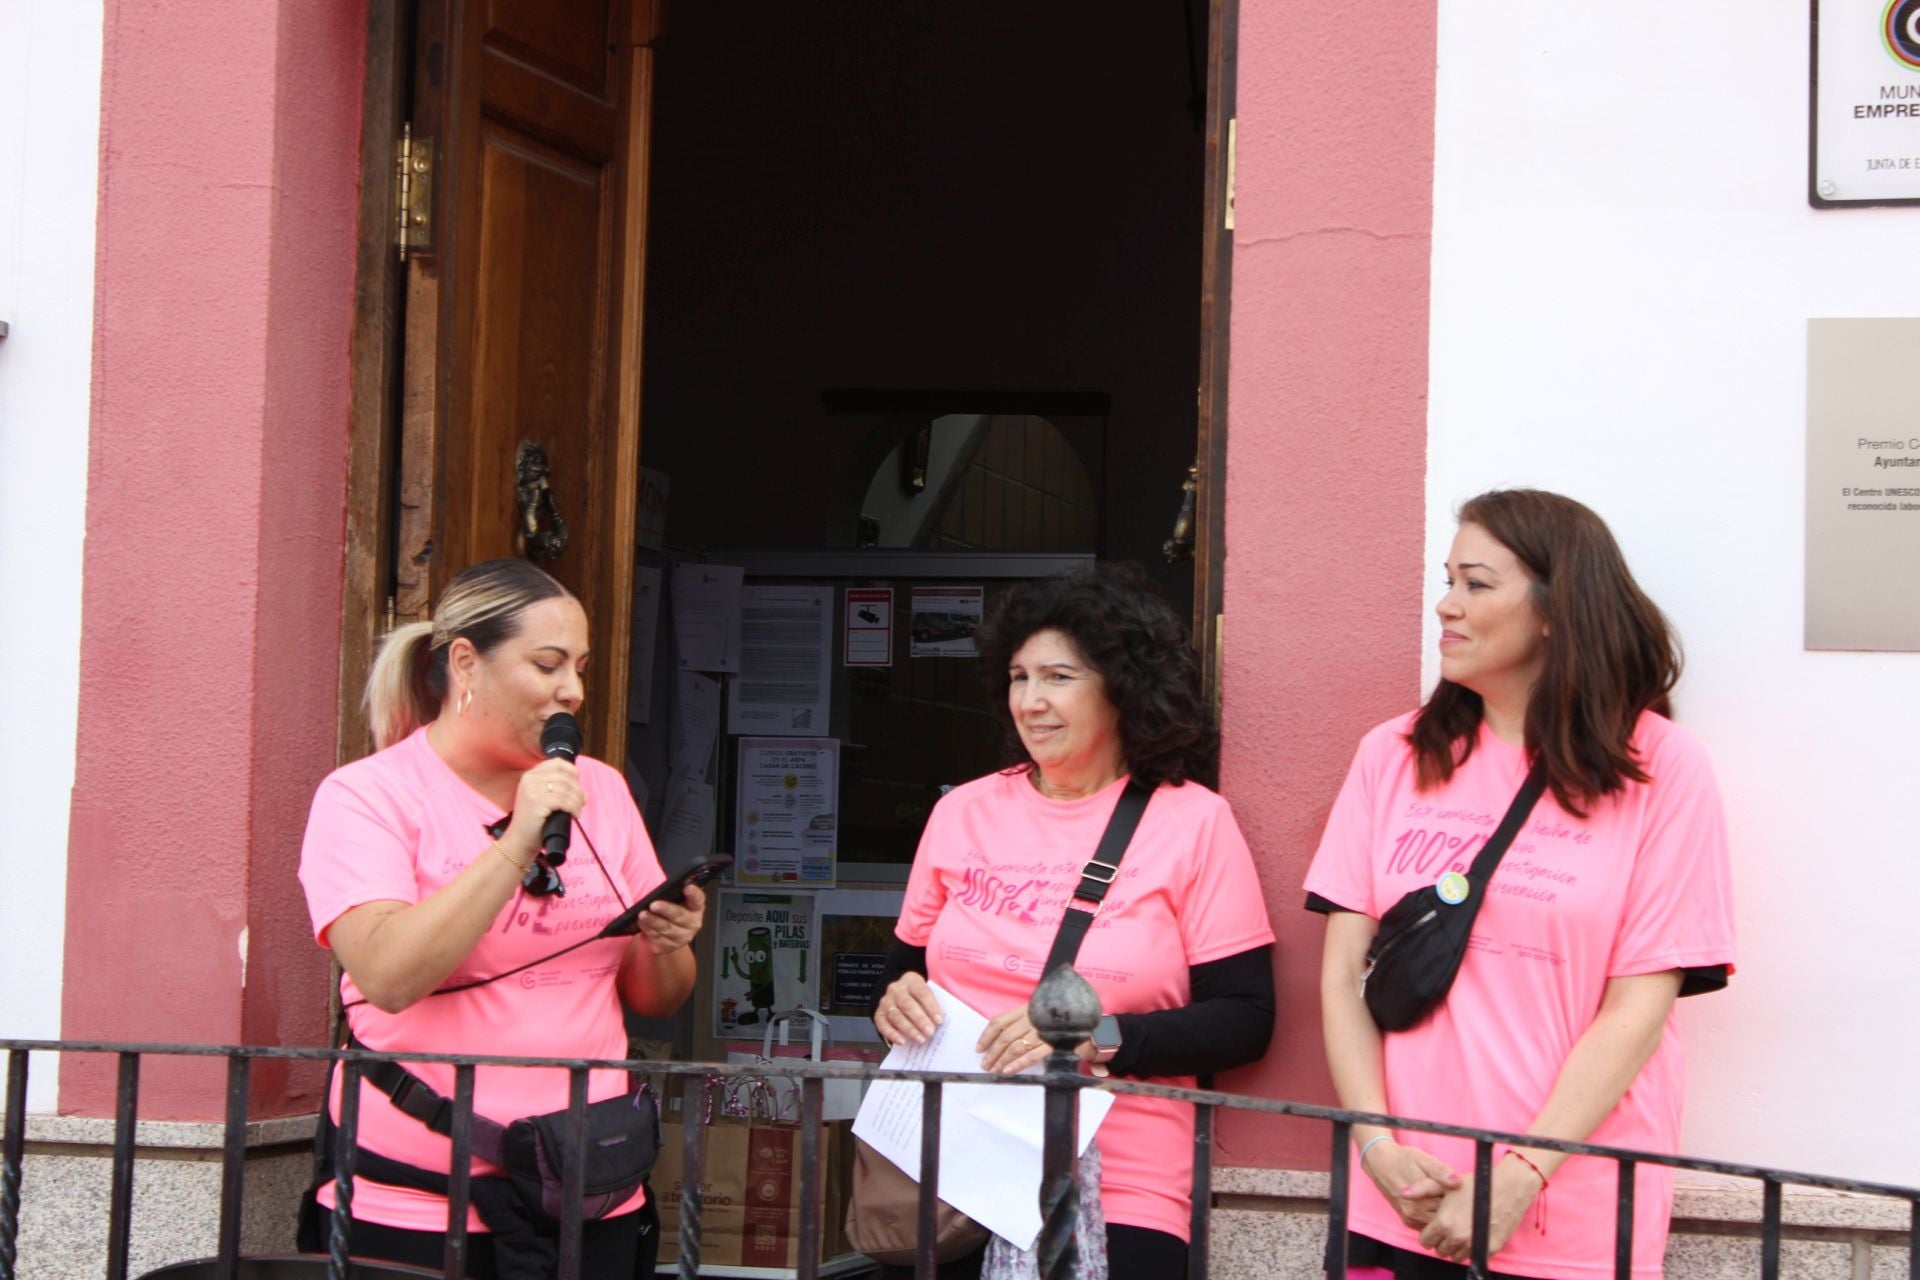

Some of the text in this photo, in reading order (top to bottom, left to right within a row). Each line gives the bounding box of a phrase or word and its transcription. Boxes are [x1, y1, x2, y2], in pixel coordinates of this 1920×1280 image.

[1853, 104, 1920, 119] EMPRE
[1867, 158, 1895, 171] JUNTA
[1899, 158, 1911, 170] DE
[1858, 438, 1904, 450] Premio
[1842, 487, 1851, 497] El
[1853, 487, 1882, 497] Centro
[1385, 828, 1480, 879] 100%
[791, 912, 808, 924] sus
[774, 924, 805, 940] PILAS
